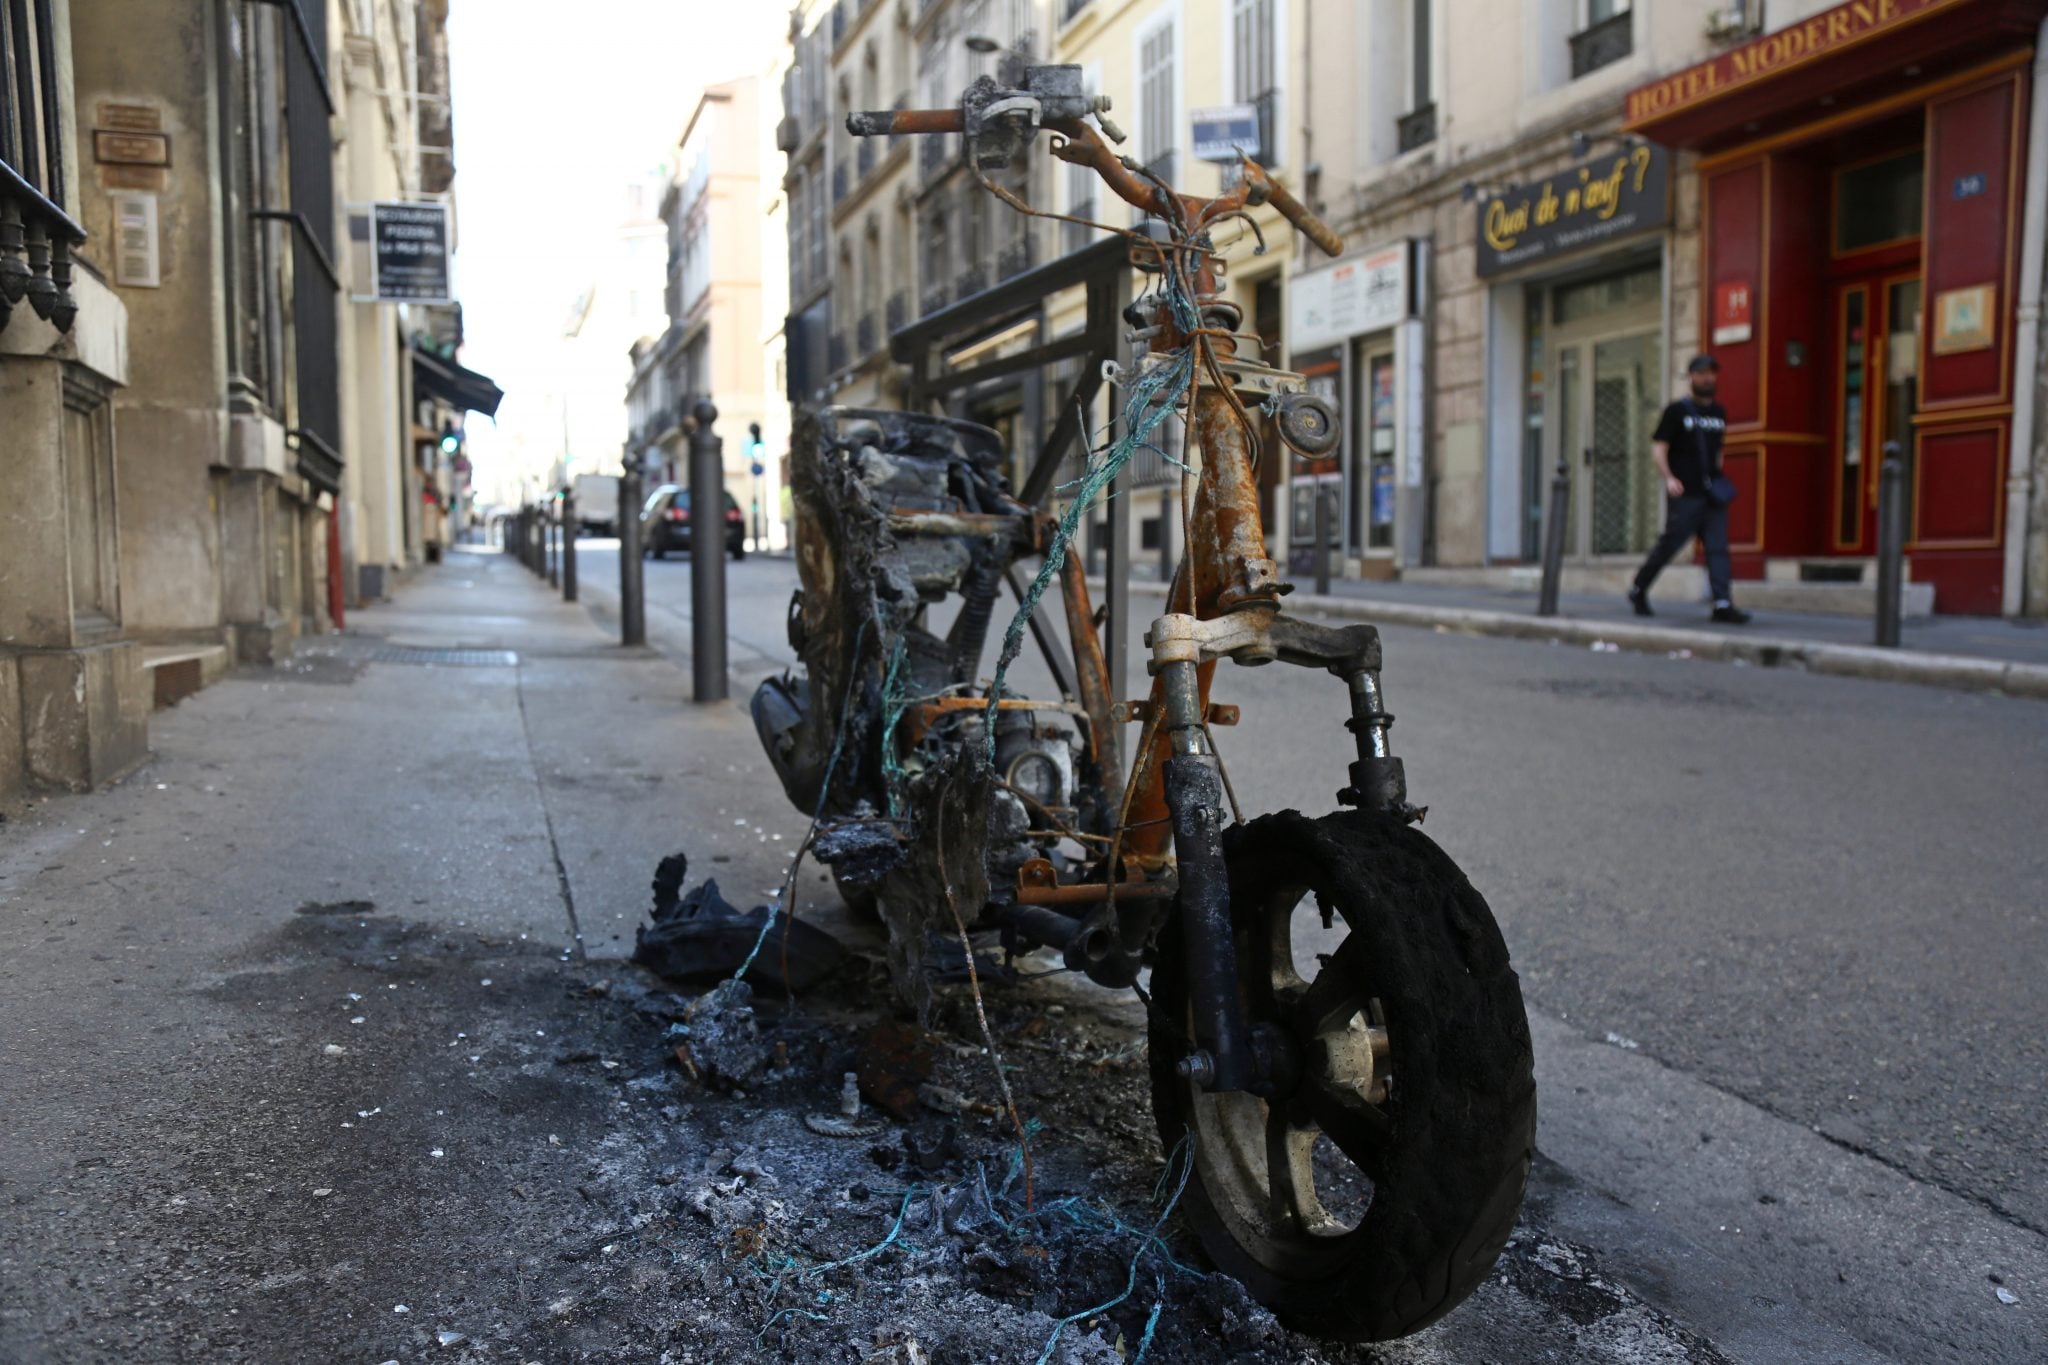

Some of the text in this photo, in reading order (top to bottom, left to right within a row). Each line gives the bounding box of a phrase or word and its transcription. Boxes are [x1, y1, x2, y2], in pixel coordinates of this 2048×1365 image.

[1631, 0, 1900, 119] HOTEL MODERNE
[1535, 183, 1558, 225] de
